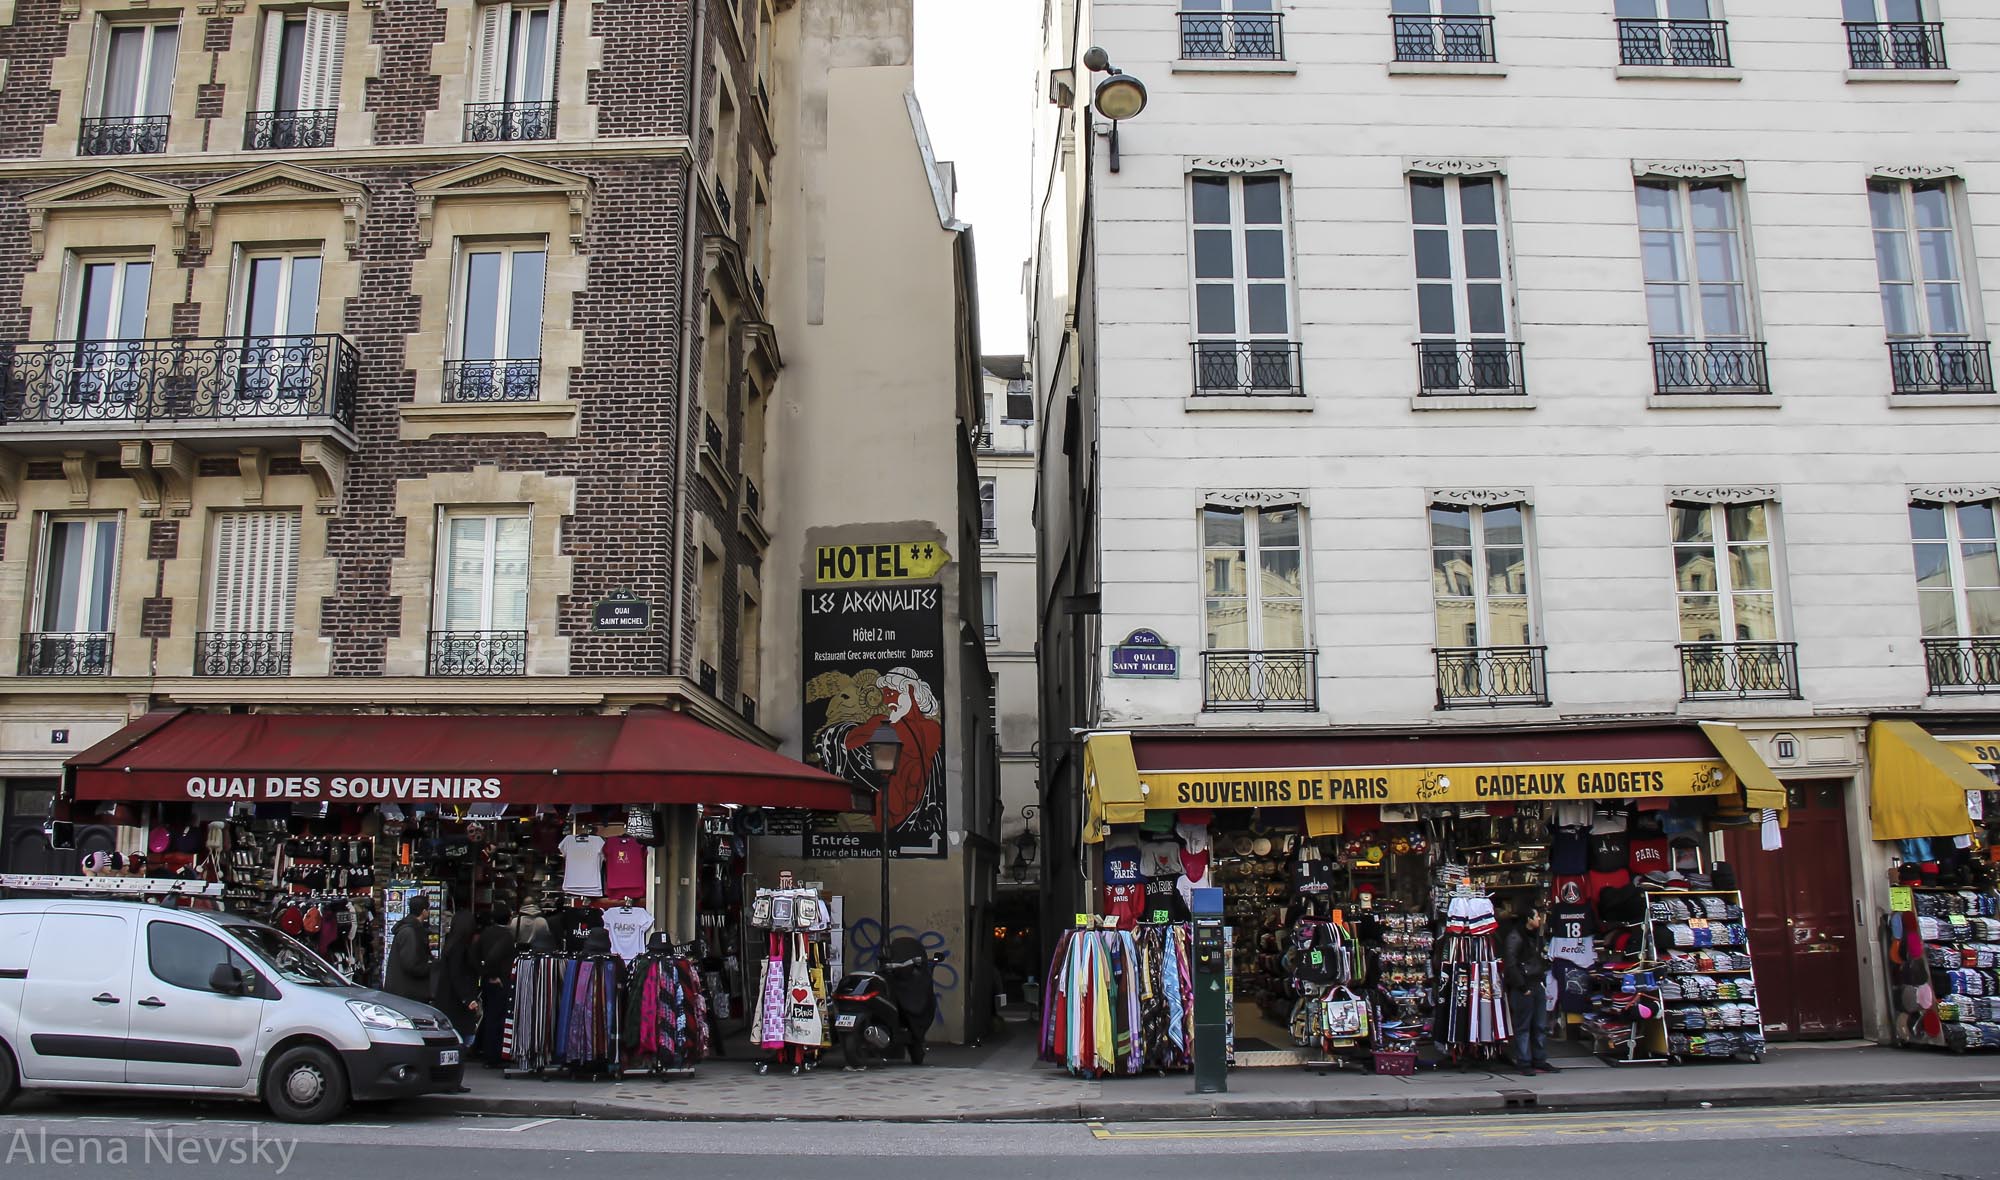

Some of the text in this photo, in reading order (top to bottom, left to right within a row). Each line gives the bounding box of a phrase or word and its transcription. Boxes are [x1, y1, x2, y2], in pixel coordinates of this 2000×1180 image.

[811, 588, 937, 614] LES ARGONAUTES
[614, 607, 630, 615] QUAI
[600, 617, 644, 625] SAINT MICHEL
[852, 627, 876, 642] Hôtel
[814, 650, 847, 661] Restaurant
[847, 649, 862, 661] Grec
[862, 652, 877, 660] avec
[911, 648, 934, 659] Danses
[1133, 653, 1155, 662] QUAI
[1113, 663, 1176, 671] SAINT MICHEL
[55, 731, 63, 742] 9
[186, 777, 501, 799] QUAI DES SOUVENIRS
[1177, 777, 1388, 803] SOUVENIRS DE PARIS
[1475, 771, 1664, 797] CADEAUX GADGETS
[812, 834, 860, 846] Entrée
[811, 848, 821, 857] 12
[838, 848, 849, 857] de
[850, 847, 859, 857] la
[1635, 848, 1660, 862] PARIS
[1565, 922, 1581, 938] 18
